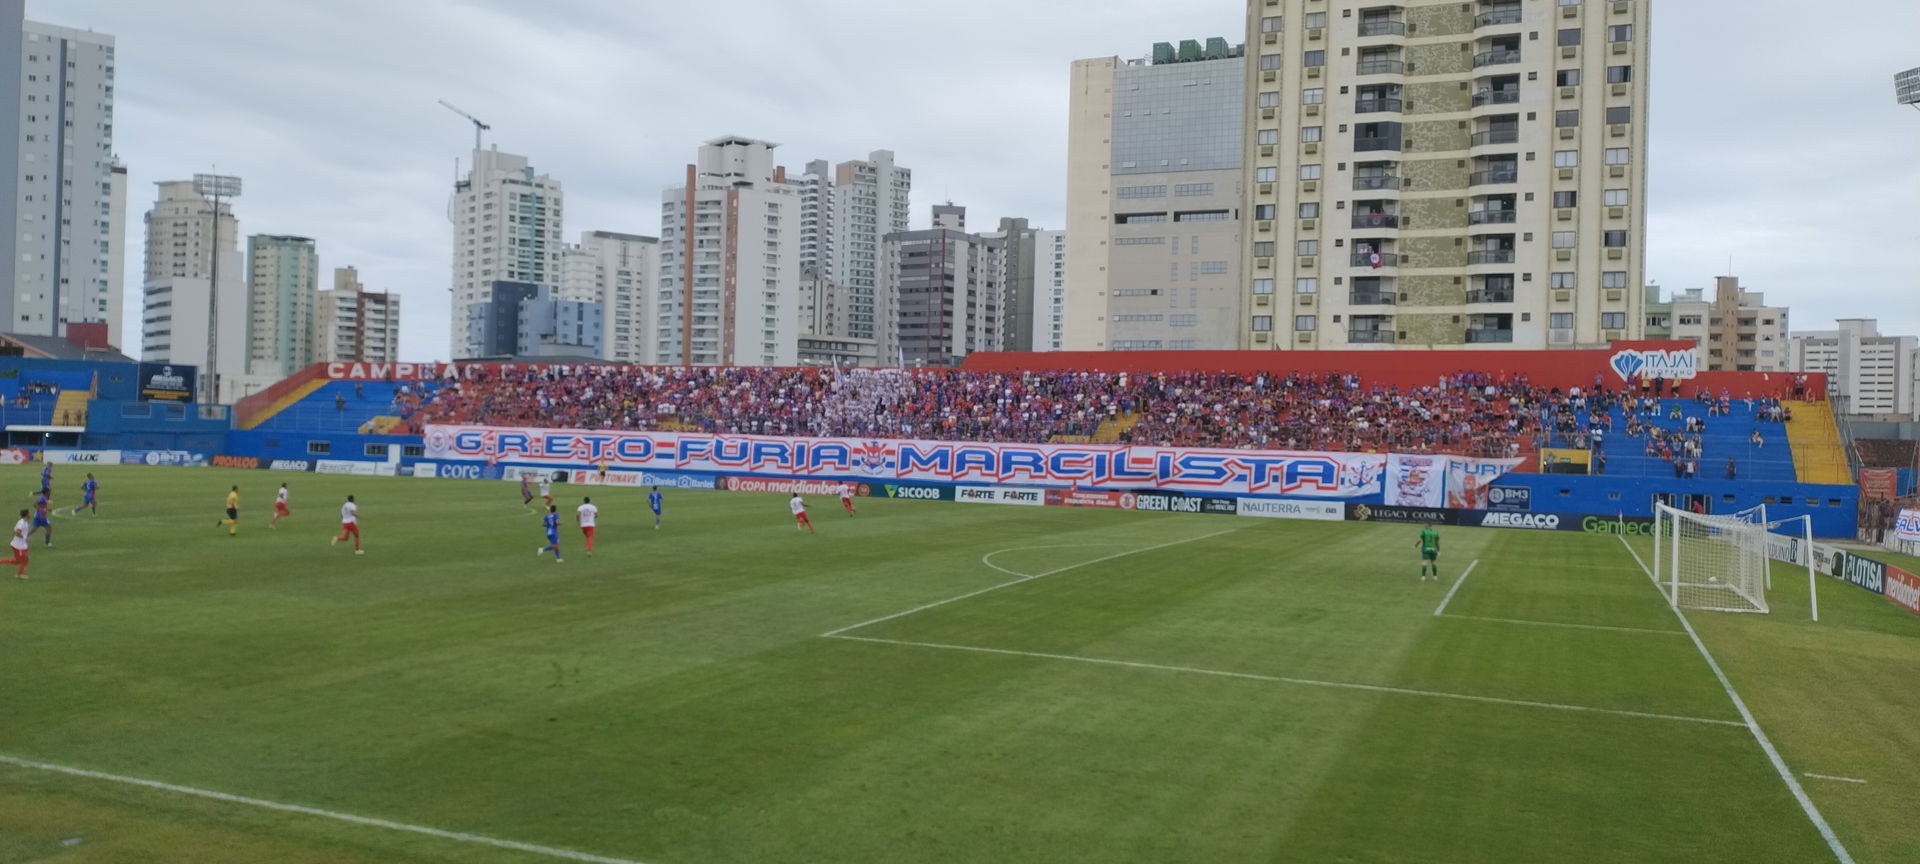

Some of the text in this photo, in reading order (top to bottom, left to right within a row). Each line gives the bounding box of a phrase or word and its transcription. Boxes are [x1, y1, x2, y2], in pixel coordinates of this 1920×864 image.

[441, 464, 480, 479] core
[897, 444, 1339, 493] MARCILISTA
[740, 480, 766, 492] COPA
[898, 487, 940, 499] SICOOB
[1505, 489, 1528, 499] BM3
[1137, 494, 1169, 511] GREEN
[1171, 497, 1202, 513] COAST
[1243, 502, 1301, 514] NAUTERRA
[1374, 509, 1407, 518] LEGACY
[1482, 512, 1559, 527] MEGACO
